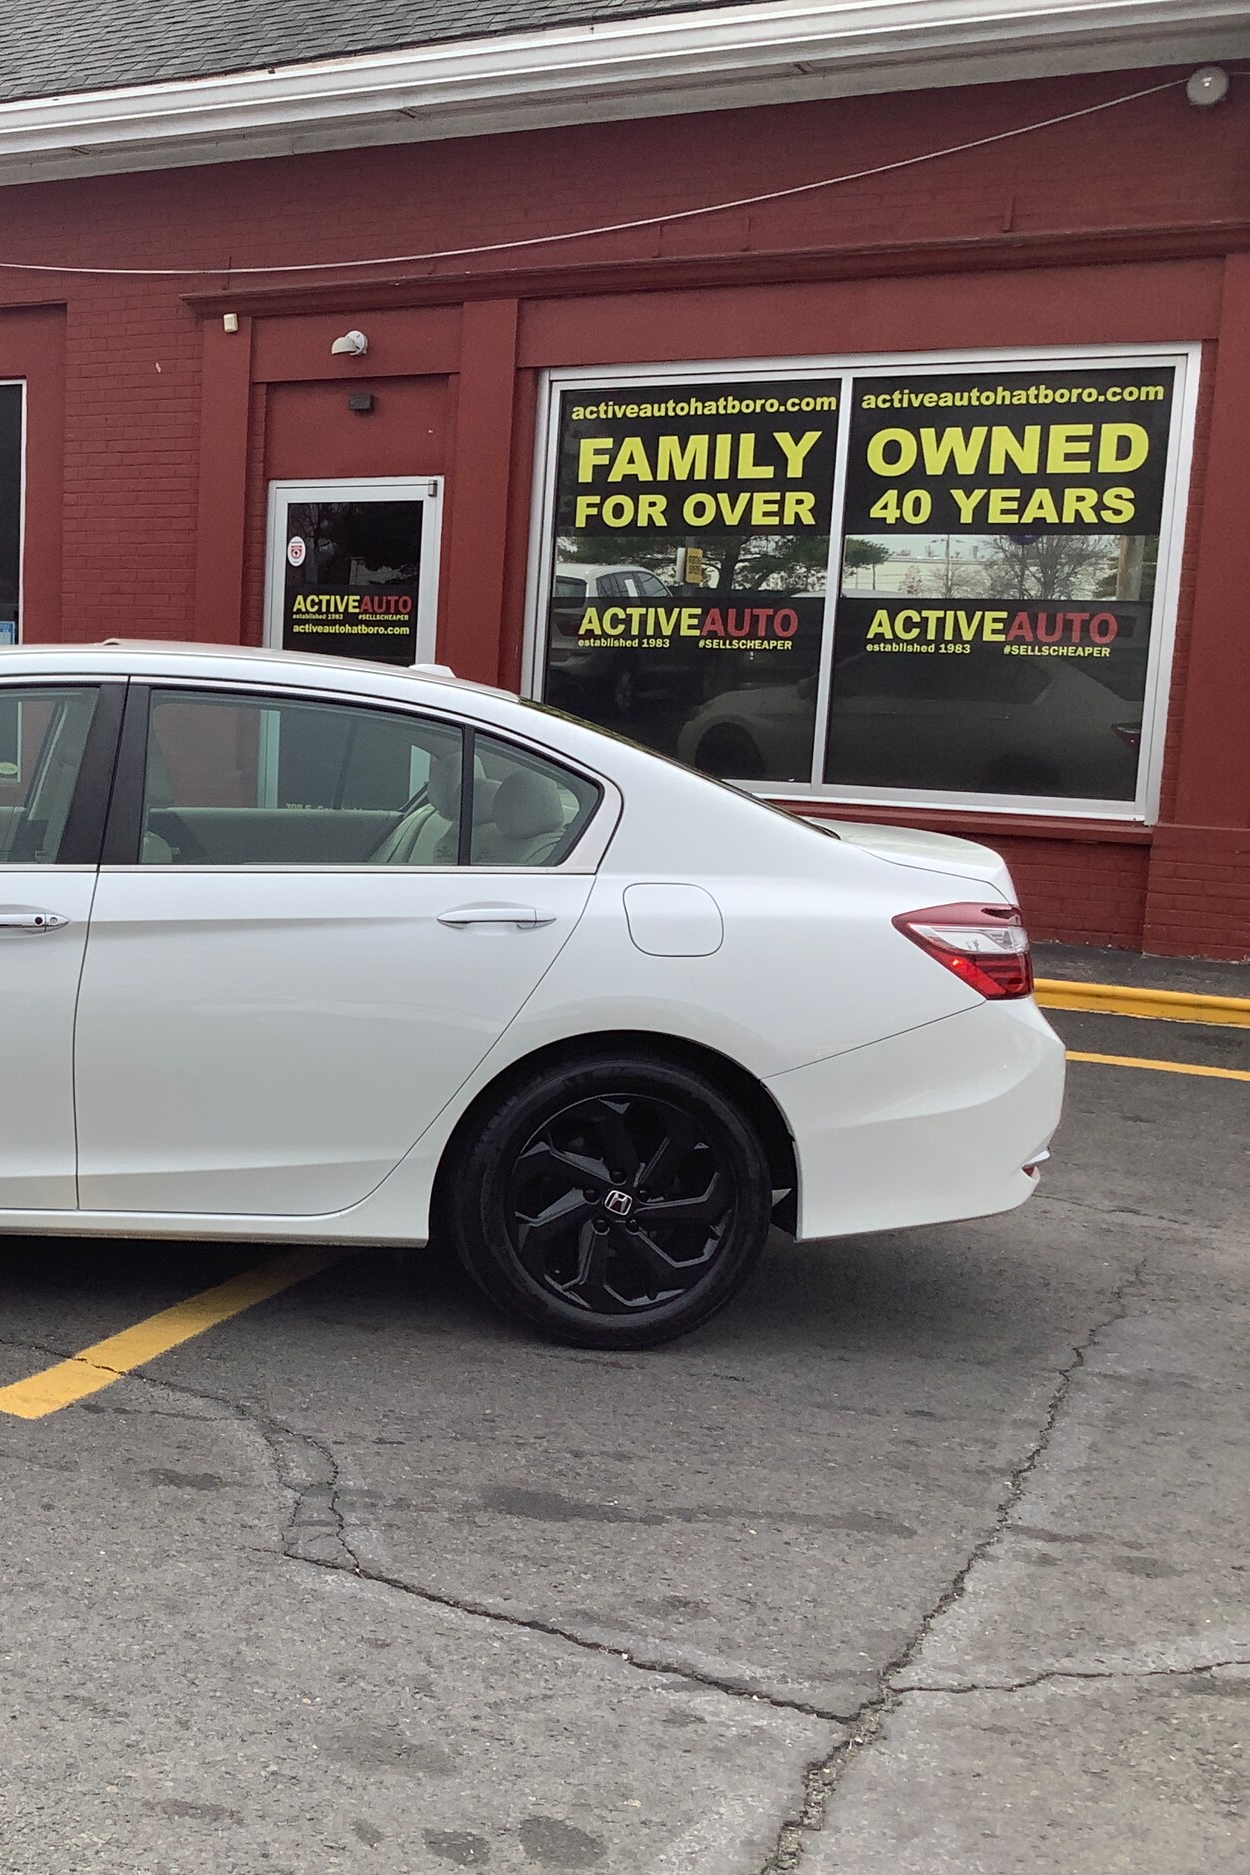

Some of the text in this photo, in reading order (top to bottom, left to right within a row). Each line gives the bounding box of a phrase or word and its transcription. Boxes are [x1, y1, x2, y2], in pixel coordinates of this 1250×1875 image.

[572, 396, 837, 420] activeautohatboro.com
[862, 385, 1165, 409] activeautohatboro.com
[578, 431, 823, 483] FAMILY
[867, 423, 1149, 476] OWNED
[575, 492, 816, 528] FOR OVER
[869, 487, 1136, 524] 40 YEARS
[292, 595, 412, 613] ACTIVEAUTO
[292, 623, 410, 635] activeautohatboro.com
[578, 607, 799, 638] ACTIVEAUTO
[866, 609, 1118, 644] ACTIVEAUTO
[578, 638, 793, 650] established 1983 #SELLSCHEAPER
[866, 643, 1111, 657] established 1983 #SELLSCHEAPER
